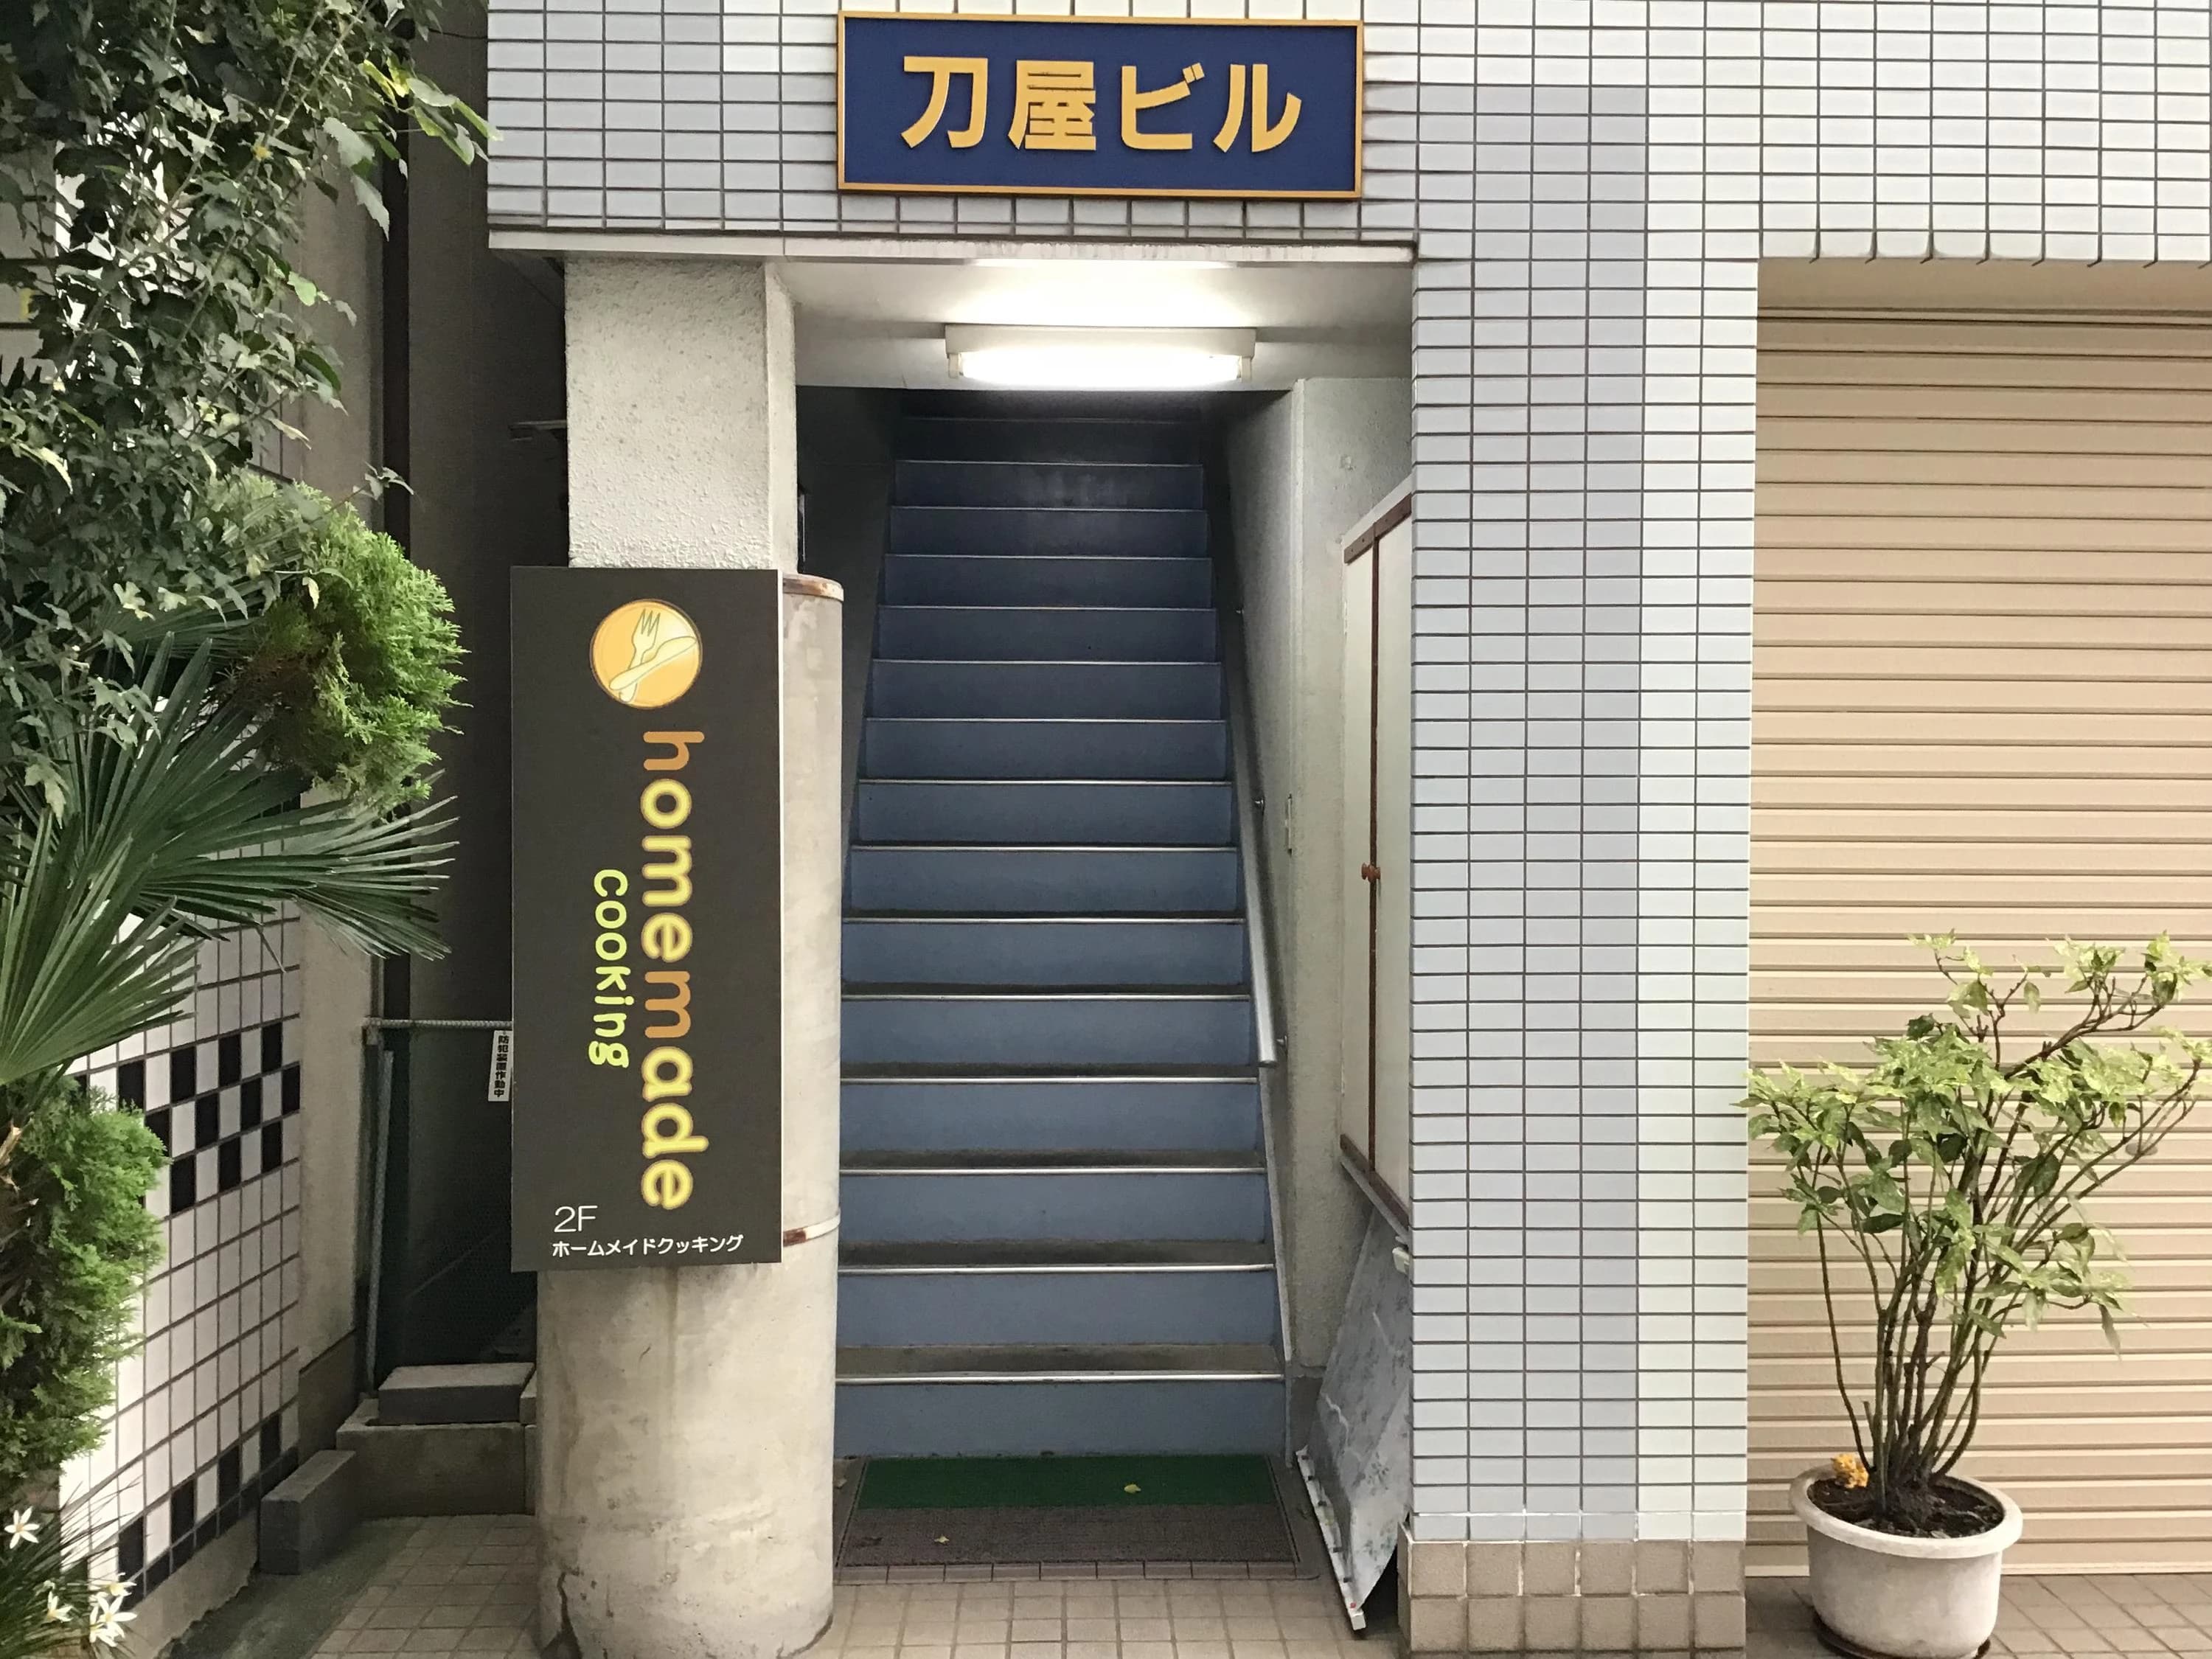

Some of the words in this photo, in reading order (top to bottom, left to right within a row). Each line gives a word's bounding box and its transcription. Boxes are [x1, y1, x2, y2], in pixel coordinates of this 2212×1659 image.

[901, 55, 1302, 153] 刀屋ビル
[588, 869, 634, 1068] cooking
[640, 731, 709, 1209] homemade
[552, 1234, 743, 1257] ホームメイドクッキング
[554, 1206, 598, 1233] 2F
